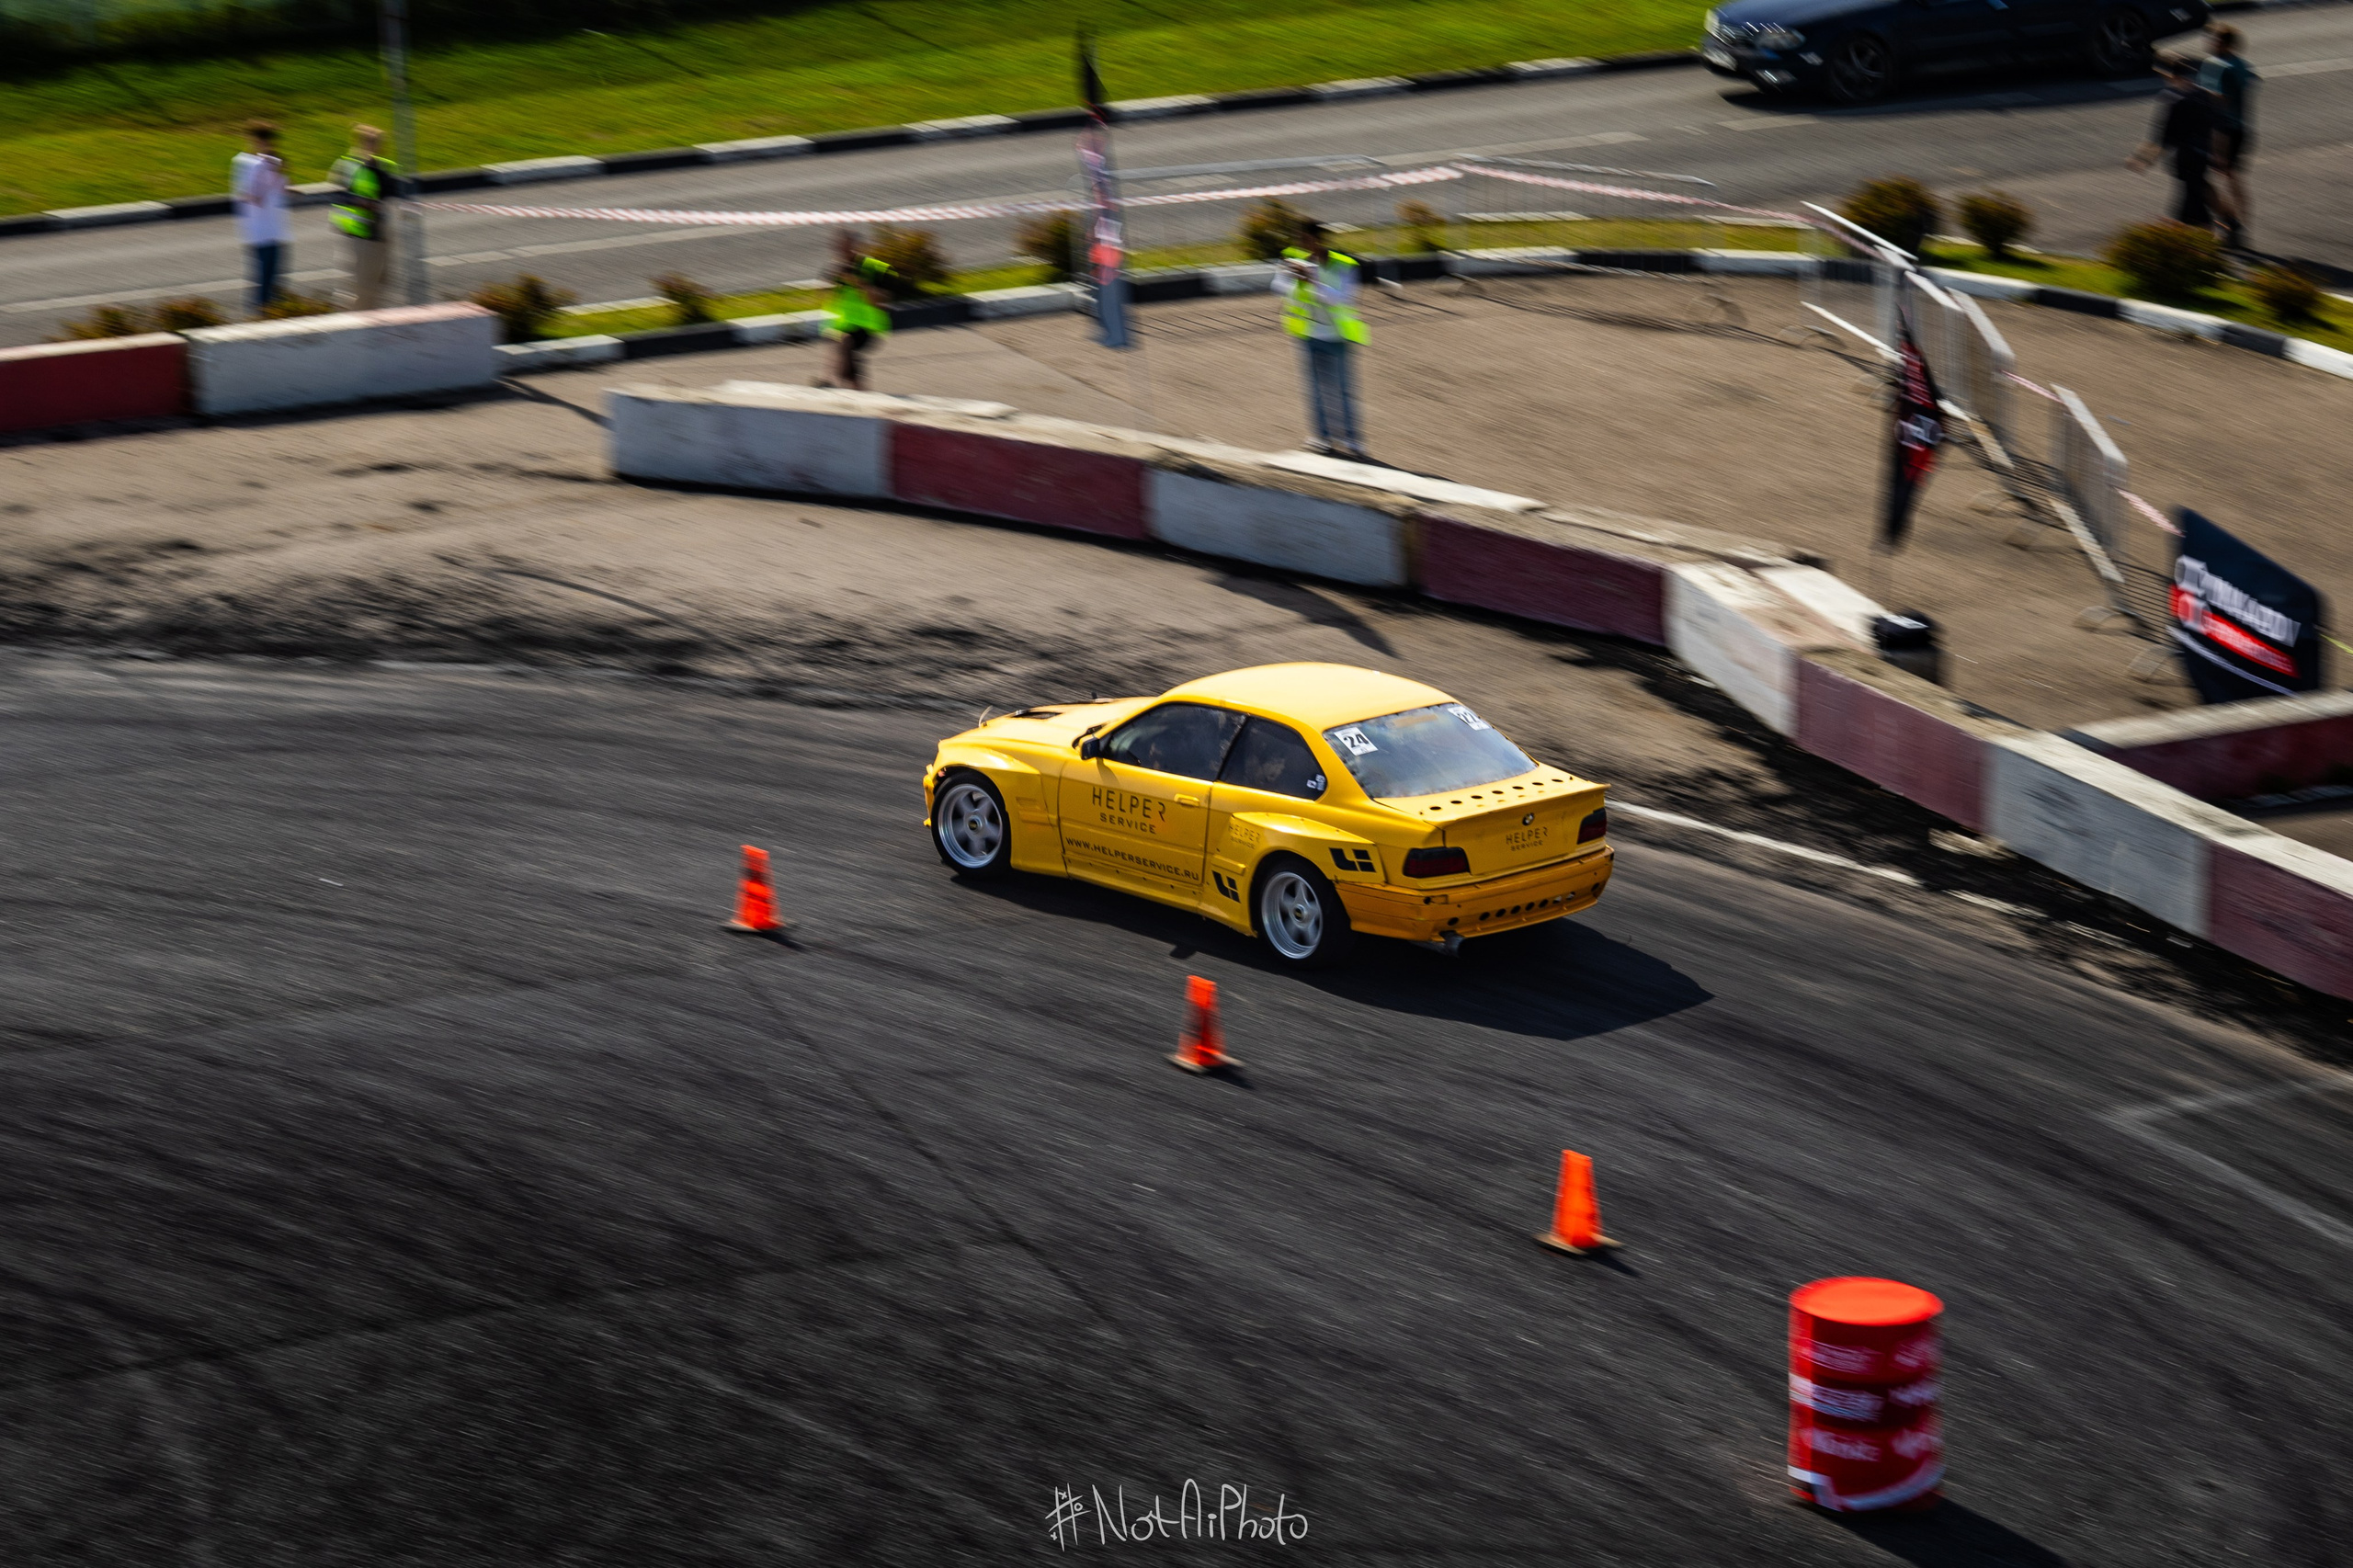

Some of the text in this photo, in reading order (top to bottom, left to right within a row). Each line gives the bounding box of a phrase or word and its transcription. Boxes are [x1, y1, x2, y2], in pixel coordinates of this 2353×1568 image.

[1344, 733, 1370, 748] 24
[1092, 786, 1166, 823] HELPER
[1100, 812, 1156, 835] SERVICE
[1506, 826, 1548, 845] HELPER
[1510, 840, 1543, 852] SERVICE
[1066, 837, 1199, 881] WWW.HELPERSERVICE.RU
